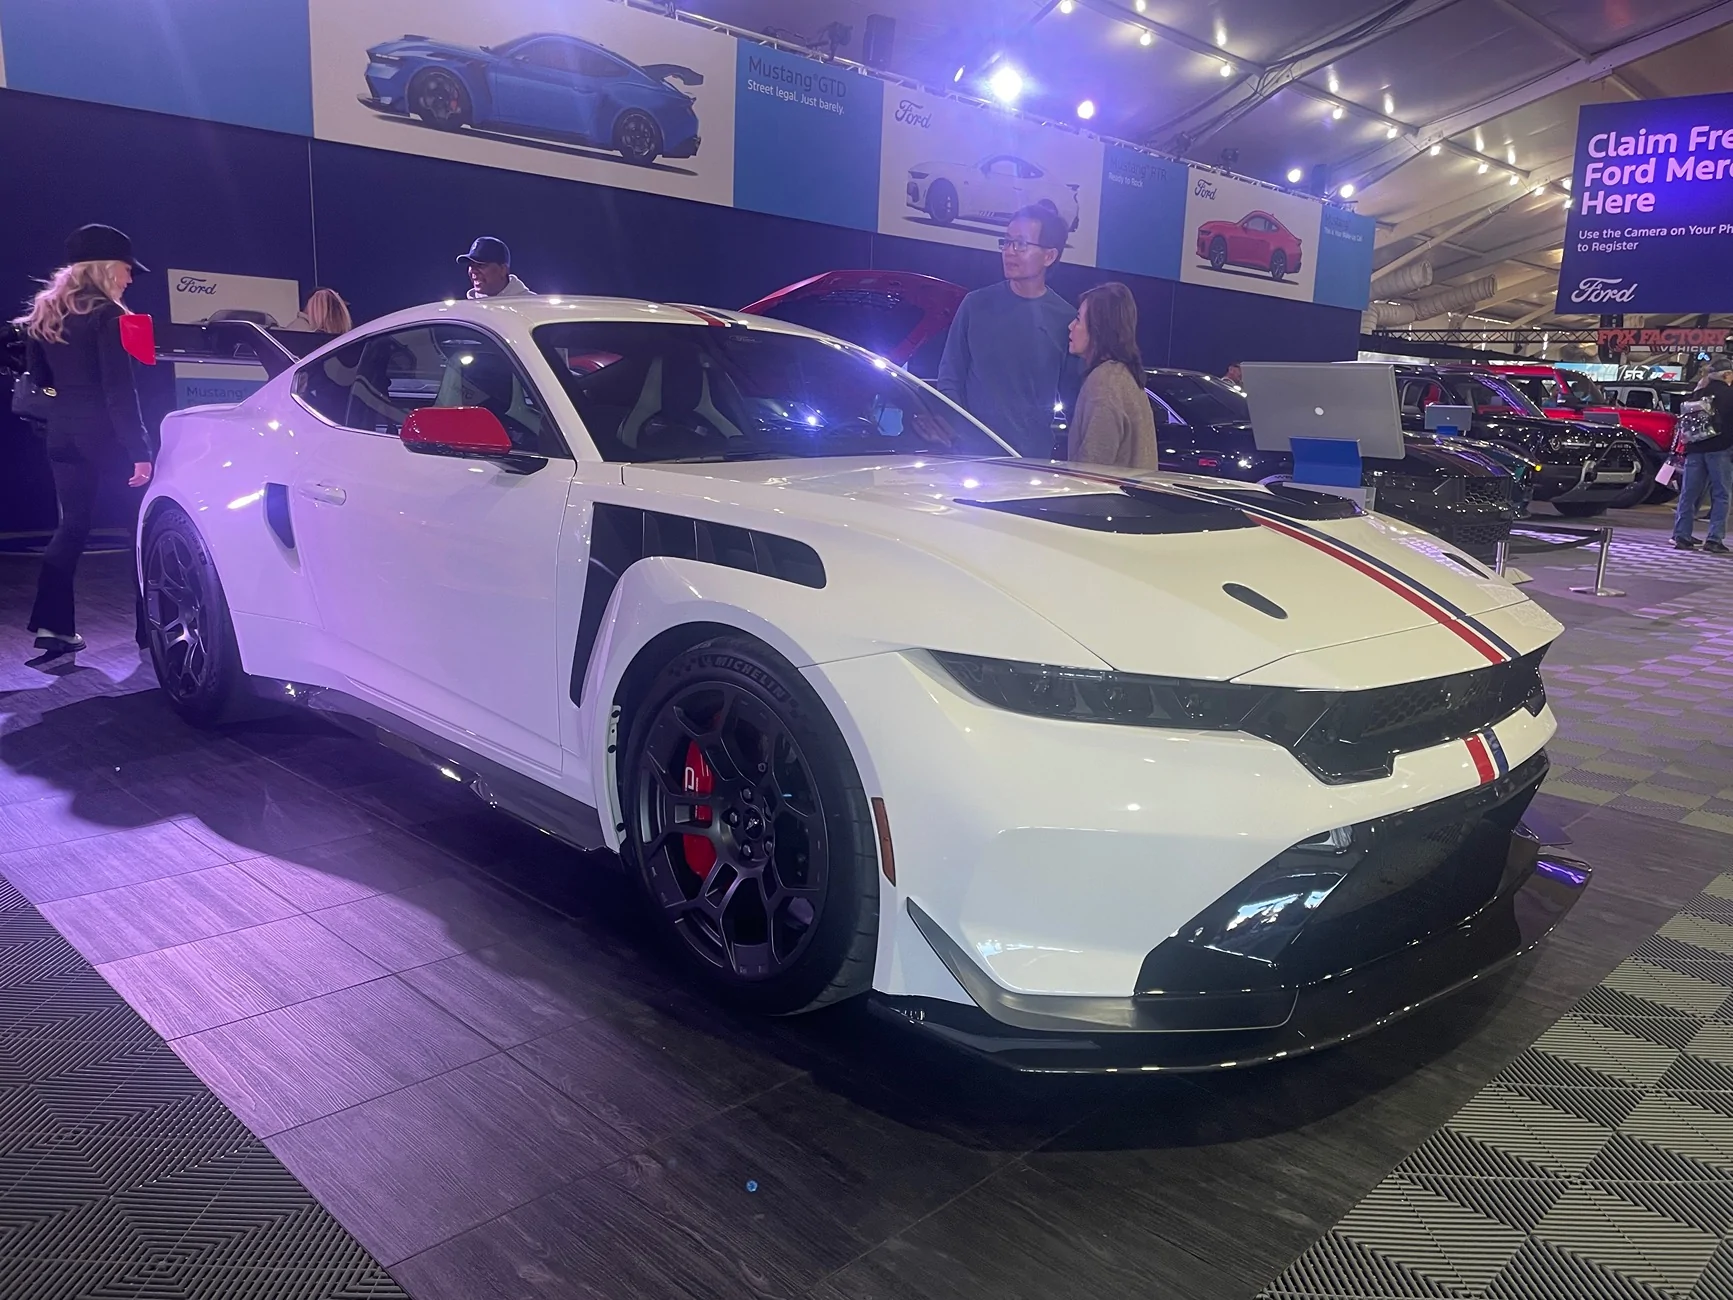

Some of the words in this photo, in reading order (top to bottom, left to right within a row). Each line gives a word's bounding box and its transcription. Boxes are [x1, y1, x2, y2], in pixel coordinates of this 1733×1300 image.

[747, 79, 774, 96] Street
[775, 86, 799, 102] legal.
[800, 93, 817, 107] Just
[819, 97, 845, 116] barely.
[818, 76, 847, 98] GTD
[894, 99, 933, 129] Ford
[1588, 128, 1677, 158] Claim
[1688, 125, 1733, 151] Fre
[1108, 171, 1124, 185] Ready
[1124, 176, 1131, 185] to
[1131, 177, 1144, 188] Rock
[1584, 157, 1656, 187] Ford
[1665, 156, 1733, 182] Mer
[1194, 178, 1218, 201] Ford
[1581, 190, 1656, 215] Here
[1578, 229, 1600, 240] Use
[1603, 228, 1622, 239] the
[1624, 227, 1668, 238] Camera
[1670, 227, 1686, 236] on
[1688, 225, 1717, 235] Your
[1718, 224, 1733, 235] Ph
[1577, 242, 1589, 252] to
[1591, 240, 1639, 253] Register
[175, 275, 218, 295] Ford
[1570, 276, 1639, 304] Ford
[1597, 328, 1638, 353] FOX
[1638, 328, 1729, 346] FACTORY
[1660, 345, 1724, 353] VEHICLES
[715, 654, 790, 701] MICHELIN
